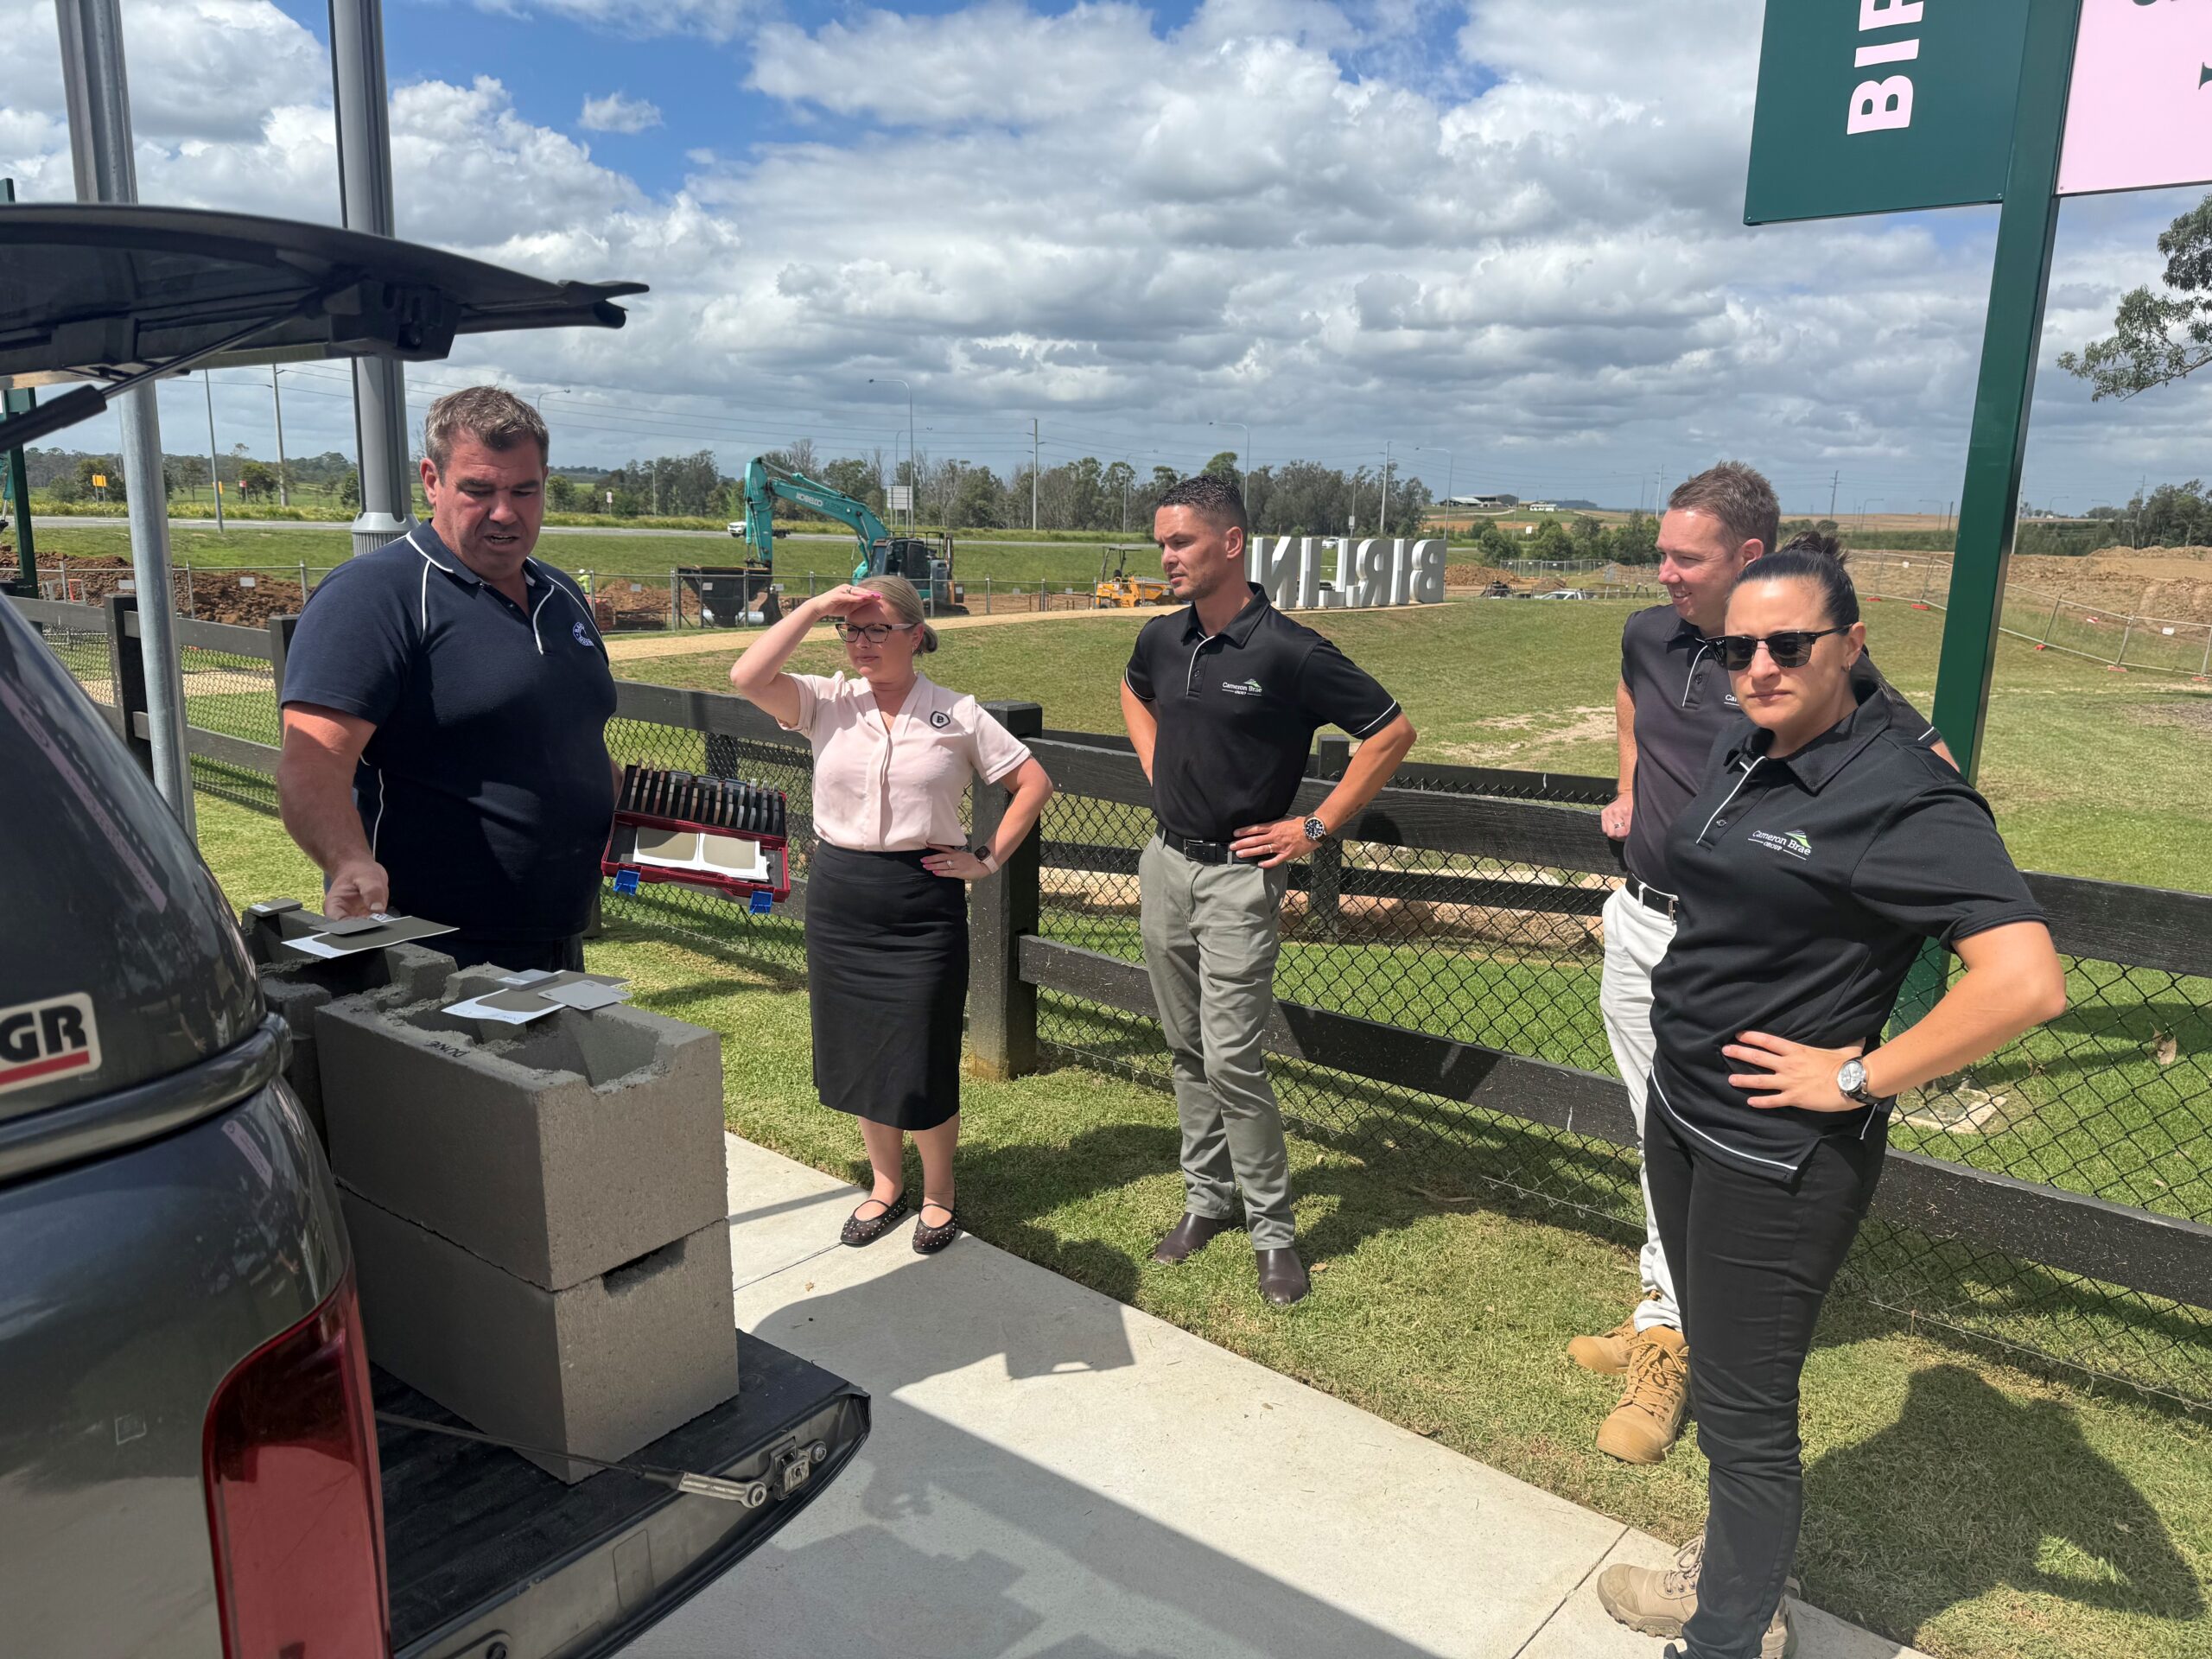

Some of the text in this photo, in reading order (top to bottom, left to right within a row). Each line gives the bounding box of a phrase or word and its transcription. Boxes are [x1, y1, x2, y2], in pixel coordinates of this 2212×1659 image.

[1222, 682, 1248, 691] Cameron
[1752, 830, 1811, 855] Cameron Brae
[1763, 841, 1783, 851] GROUP
[0, 1005, 88, 1064] GR
